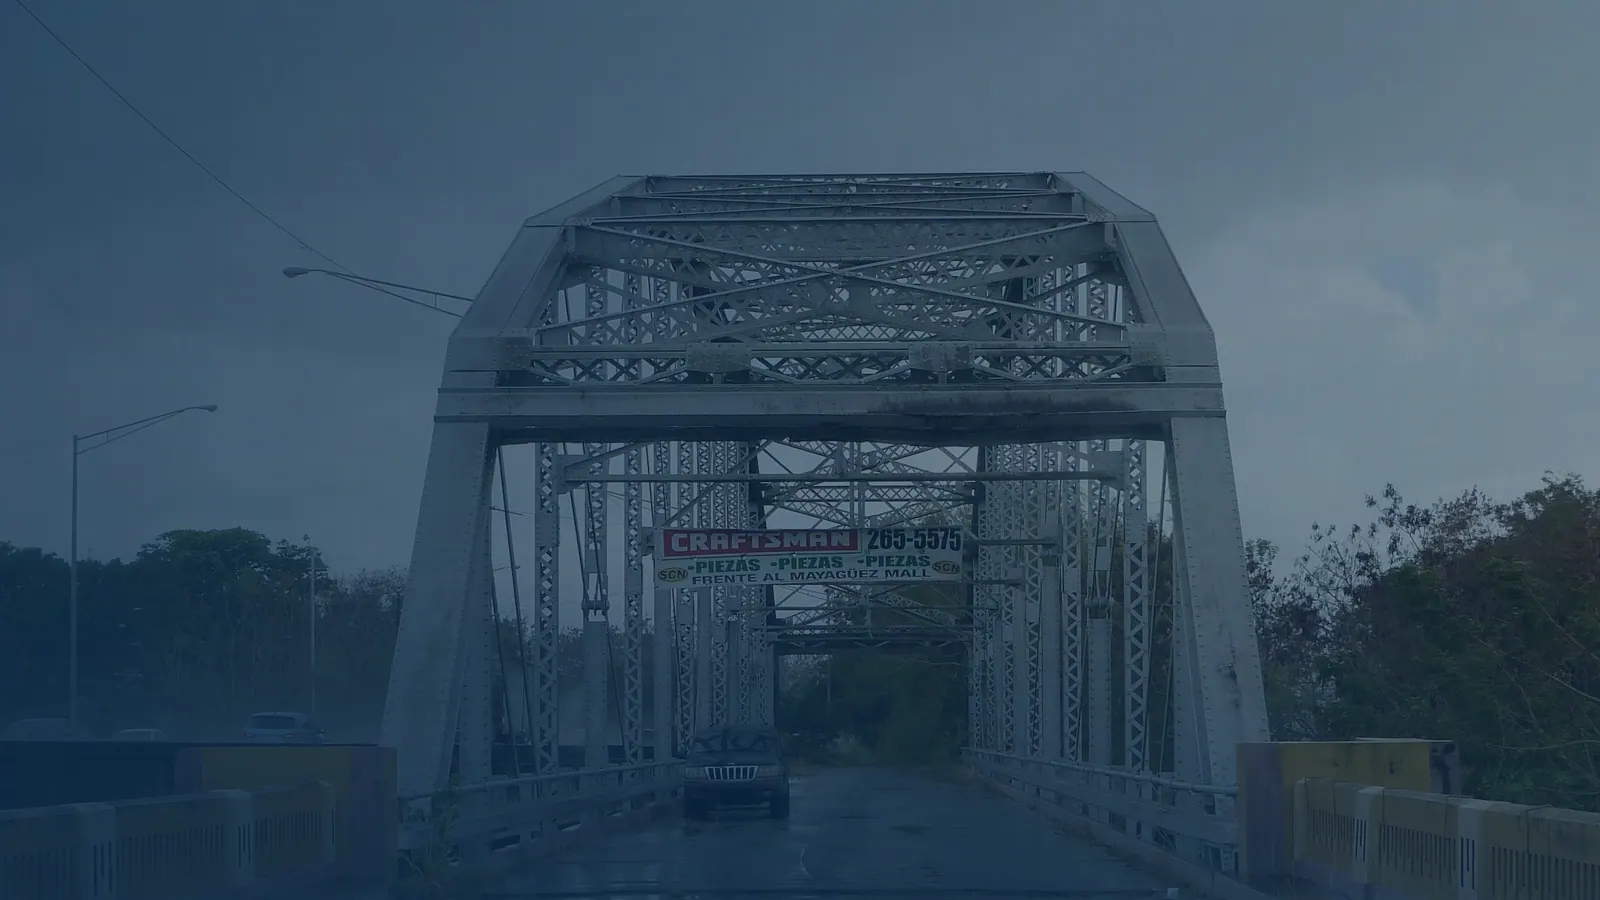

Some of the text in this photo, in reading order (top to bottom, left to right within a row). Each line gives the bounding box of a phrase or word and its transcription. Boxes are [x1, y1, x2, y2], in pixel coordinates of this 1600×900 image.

[671, 531, 852, 552] CRAFTSMAN
[868, 528, 961, 551] 265-5575
[933, 561, 959, 571] SCN
[660, 570, 687, 580] SCN
[692, 569, 931, 584] FRENTE AL MAYAGÜEZ MALL
